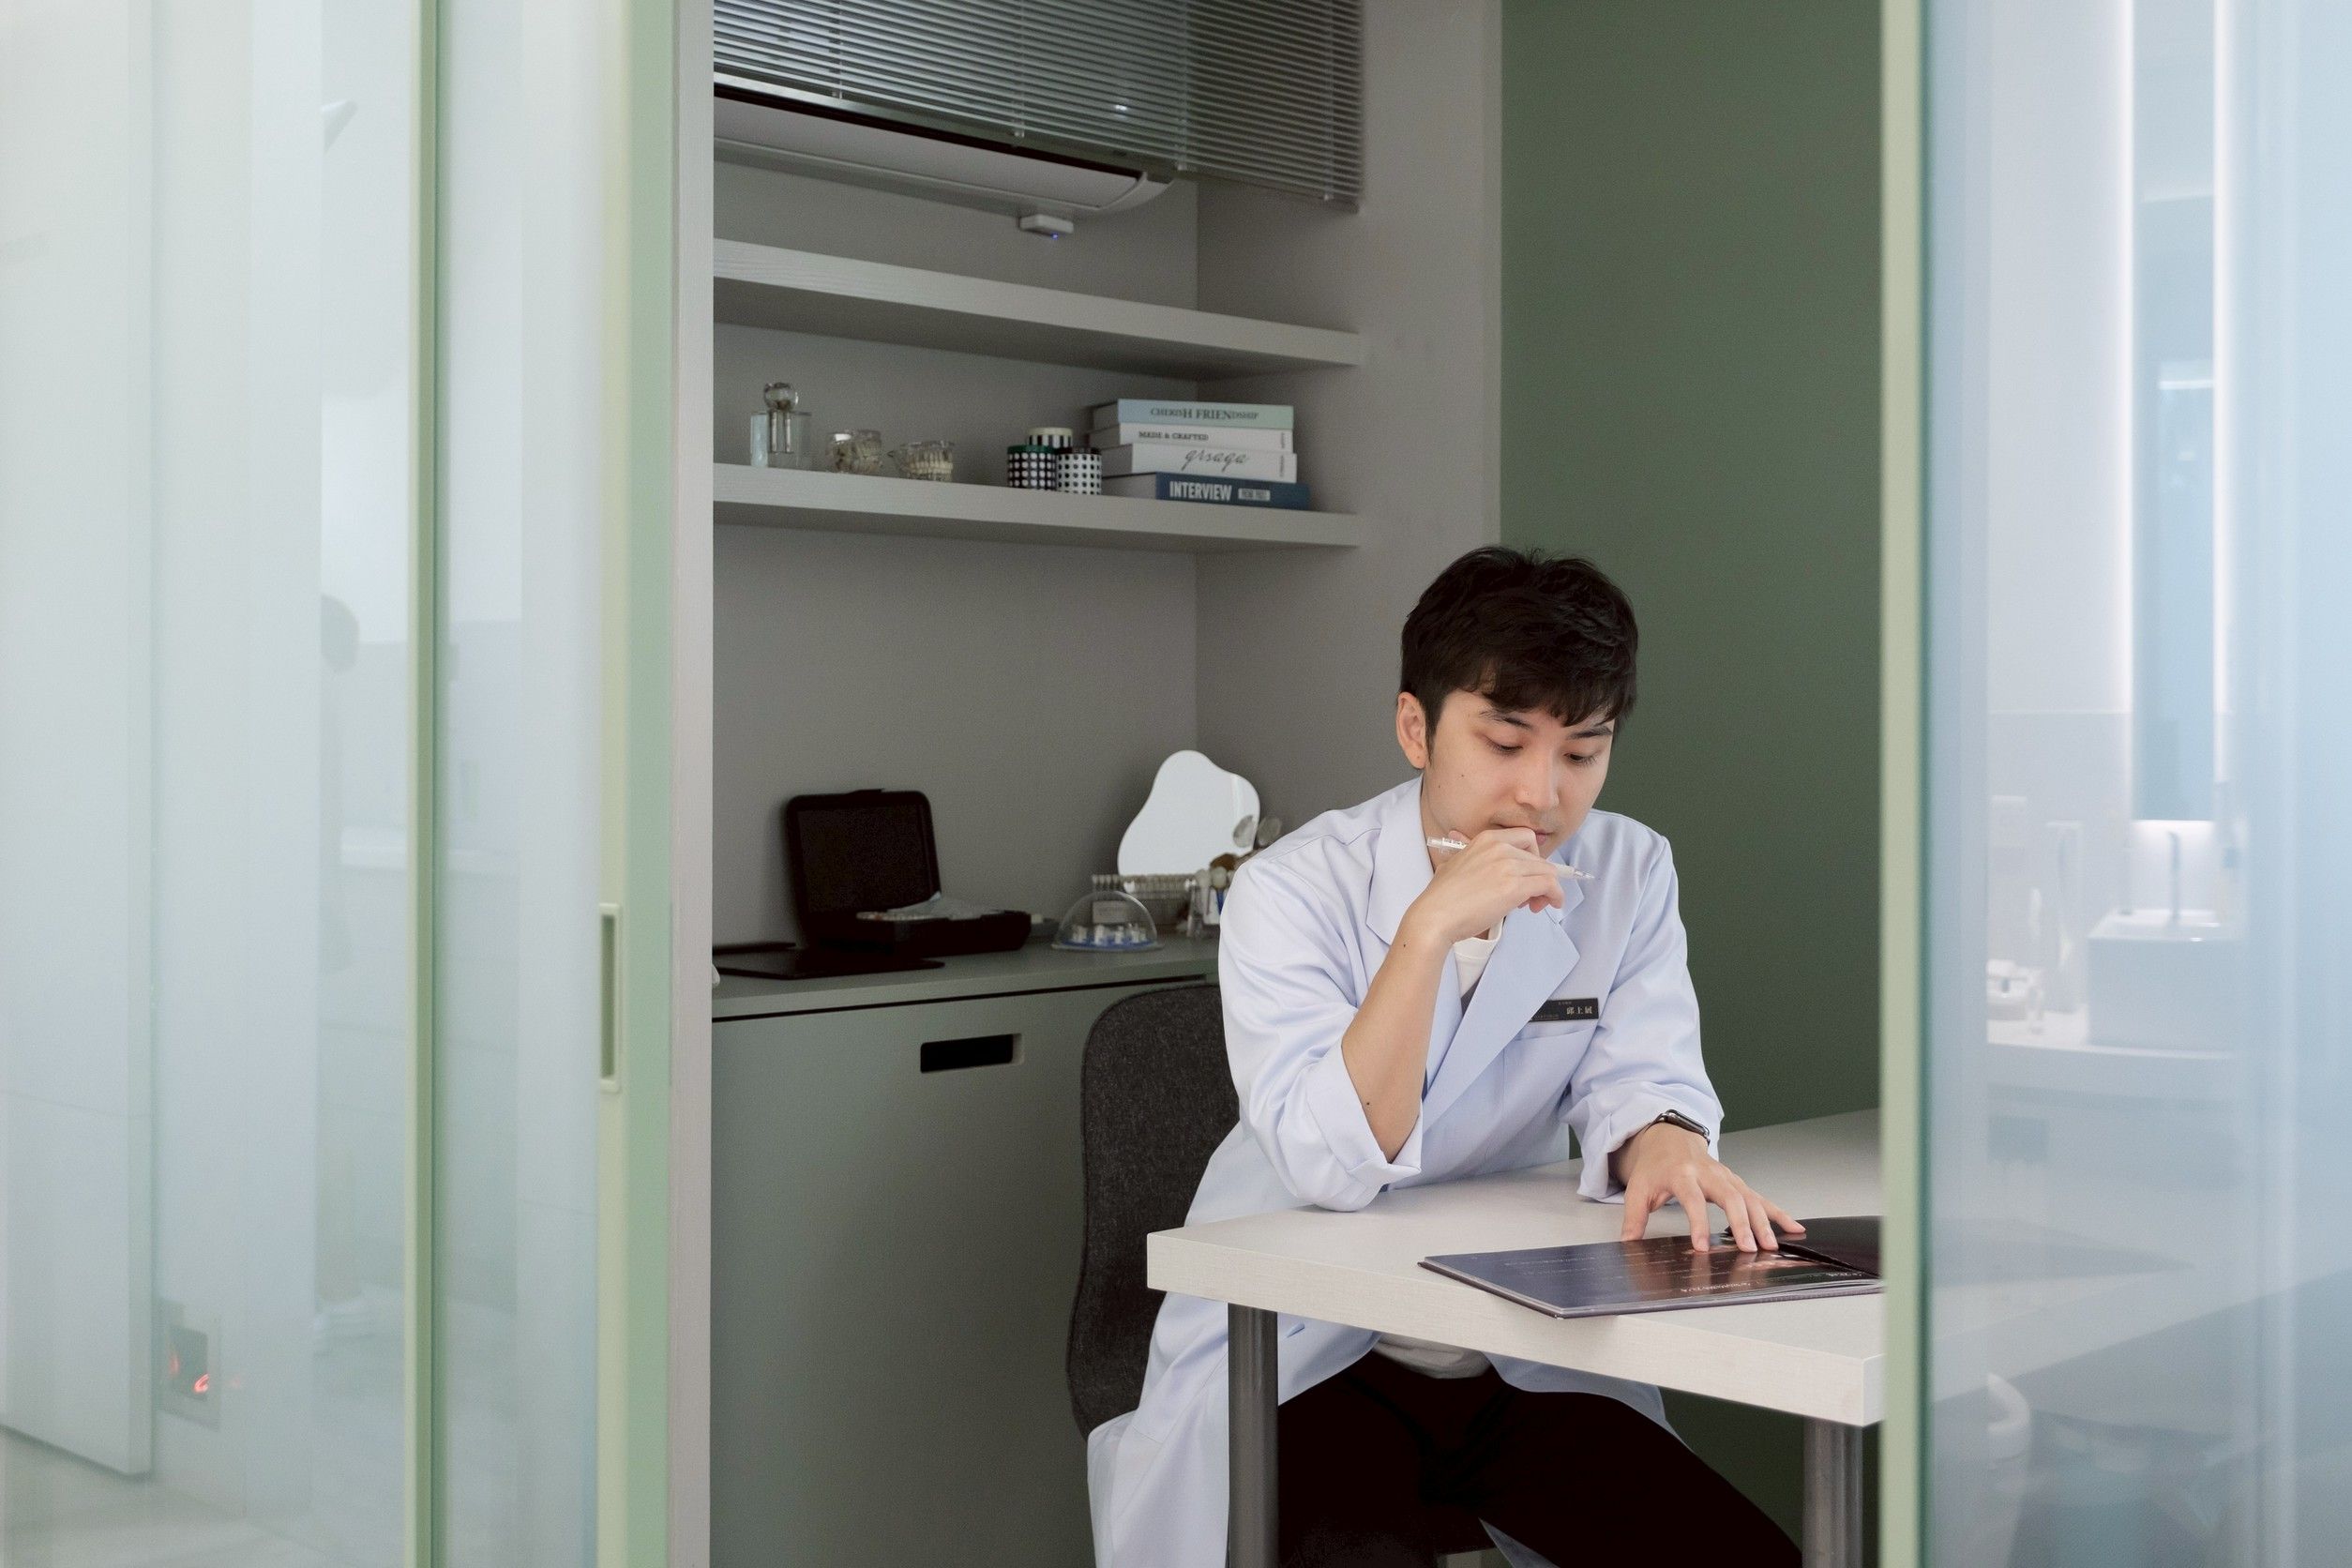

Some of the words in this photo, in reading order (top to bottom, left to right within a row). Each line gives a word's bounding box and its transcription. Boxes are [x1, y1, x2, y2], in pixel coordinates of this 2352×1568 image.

[1151, 408, 1192, 419] CHERISH
[1197, 408, 1259, 420] FRIENDSHIP
[1172, 432, 1209, 441] CRAFTED
[1169, 481, 1232, 501] INTERVIEW
